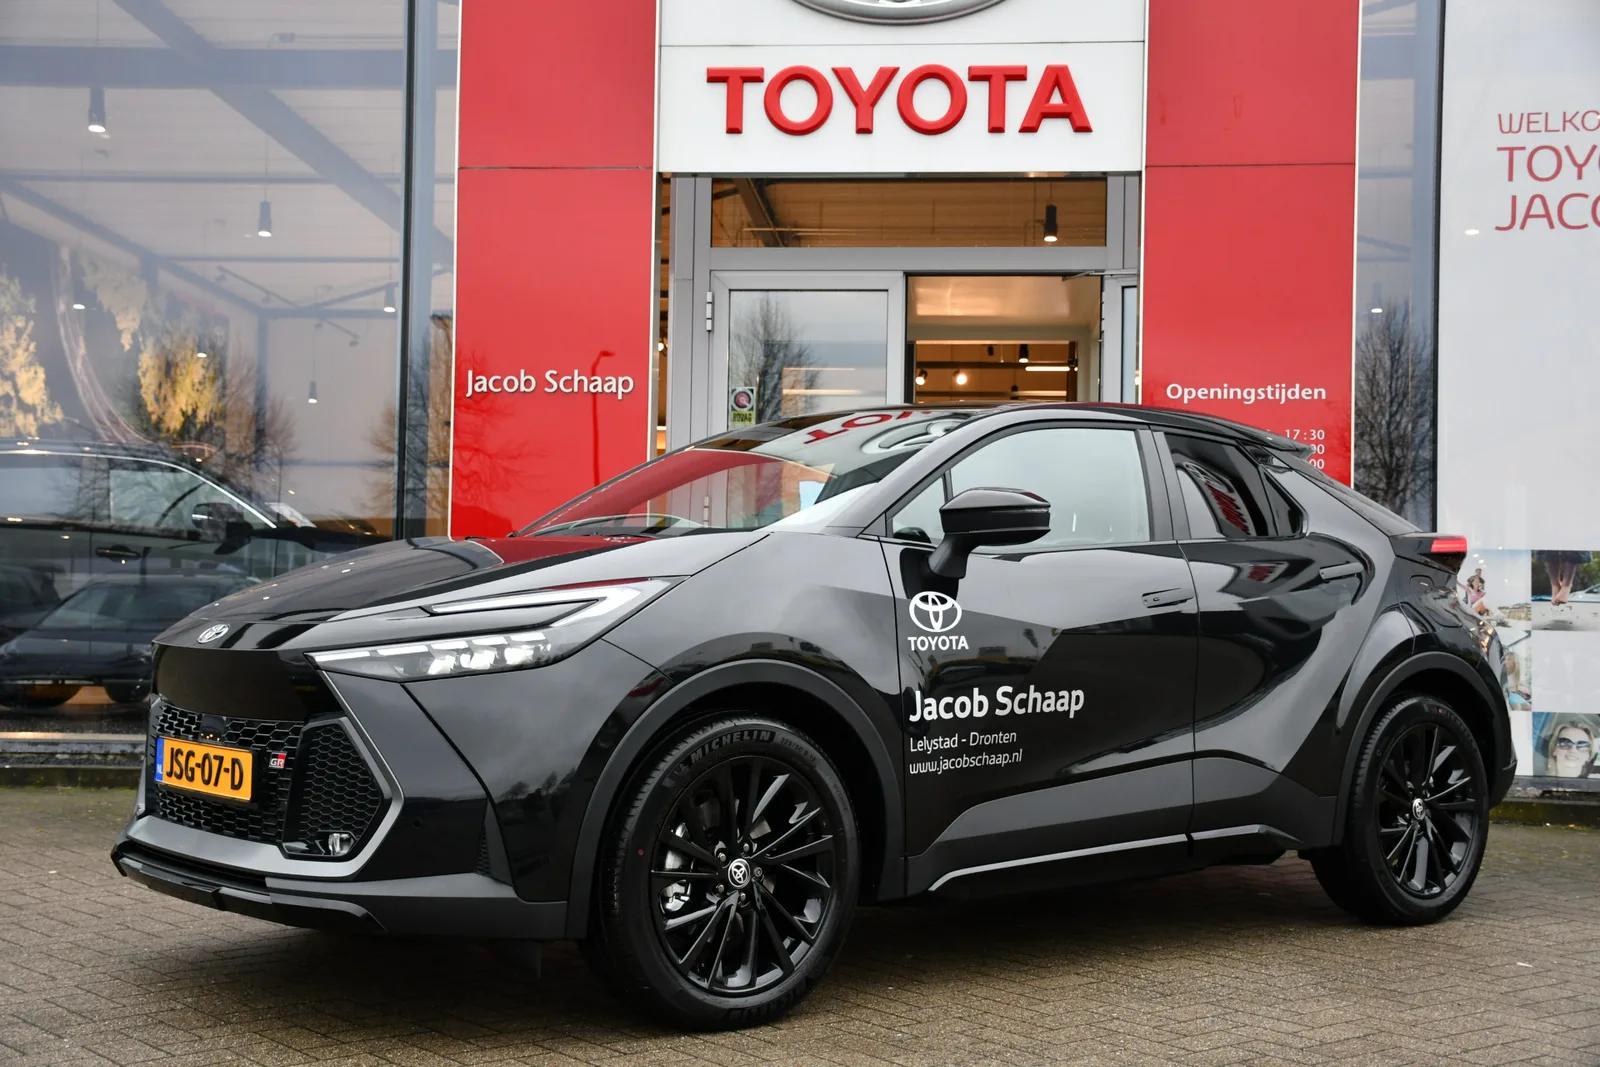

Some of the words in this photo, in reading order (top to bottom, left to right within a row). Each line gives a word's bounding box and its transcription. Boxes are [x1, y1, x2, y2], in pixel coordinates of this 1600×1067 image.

[706, 64, 1093, 136] TOYOTA
[1498, 110, 1600, 134] WELKO
[1497, 144, 1600, 182] TOY
[1495, 193, 1600, 231] JAC
[466, 369, 536, 397] Jacob
[544, 369, 634, 400] Schaap
[1166, 383, 1327, 404] Openingstijden
[907, 635, 969, 651] TOYOTA
[909, 687, 989, 722] Jacob
[995, 685, 1085, 718] Schaap
[690, 730, 771, 764] MICHELIN
[910, 734, 958, 754] Lelystad
[969, 731, 1017, 746] Dronten
[166, 747, 244, 790] JSG-07-D
[270, 758, 285, 768] GR
[909, 749, 1023, 775] www.jacobschaap.nl
